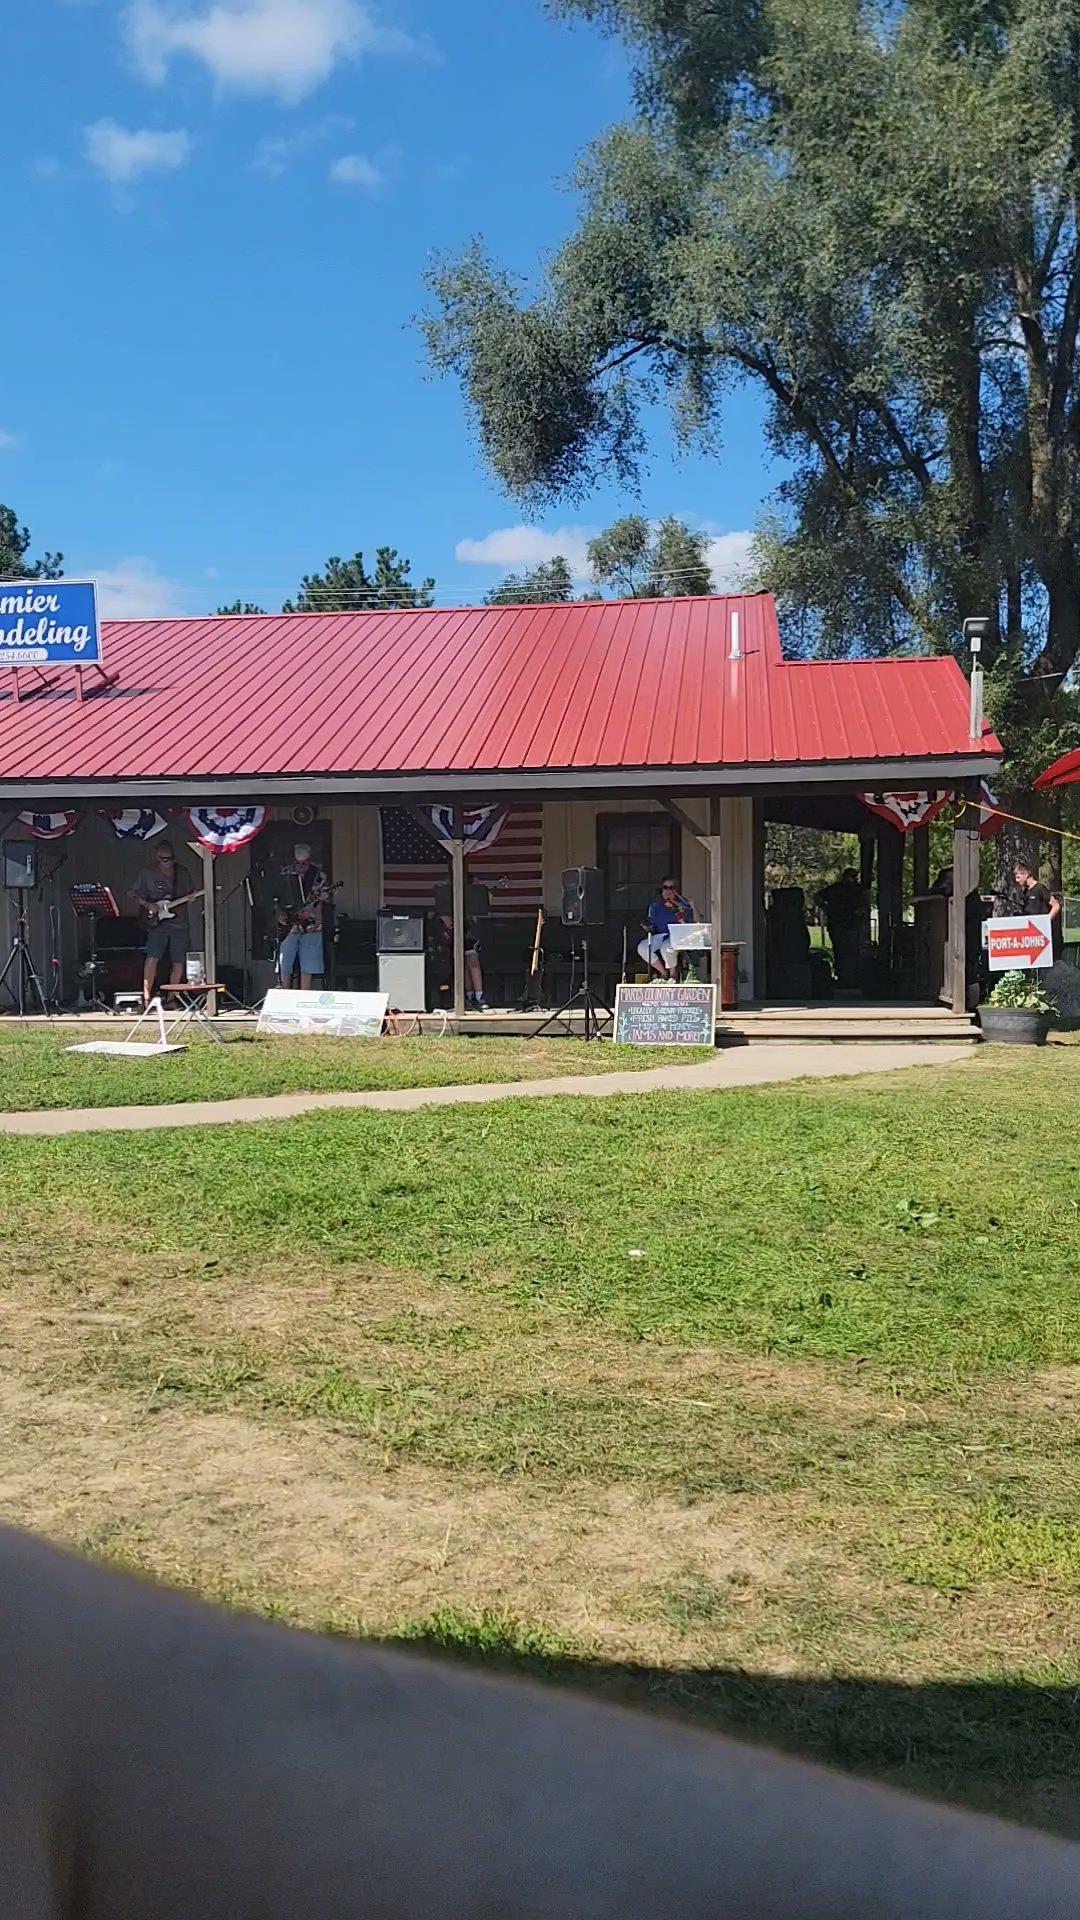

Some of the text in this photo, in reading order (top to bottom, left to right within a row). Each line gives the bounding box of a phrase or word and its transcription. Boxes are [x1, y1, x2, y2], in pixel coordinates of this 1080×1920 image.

[991, 936, 1045, 950] PORT-A-JOHNS
[645, 988, 675, 1001] COUNTRY
[677, 988, 710, 1001] GARDEN
[630, 1006, 701, 1015] LOCALLY GROWN PRODUCE
[632, 1014, 655, 1023] FRESH
[657, 1014, 678, 1023] BAKED
[628, 1028, 656, 1041] JAMS
[657, 1030, 673, 1041] AND
